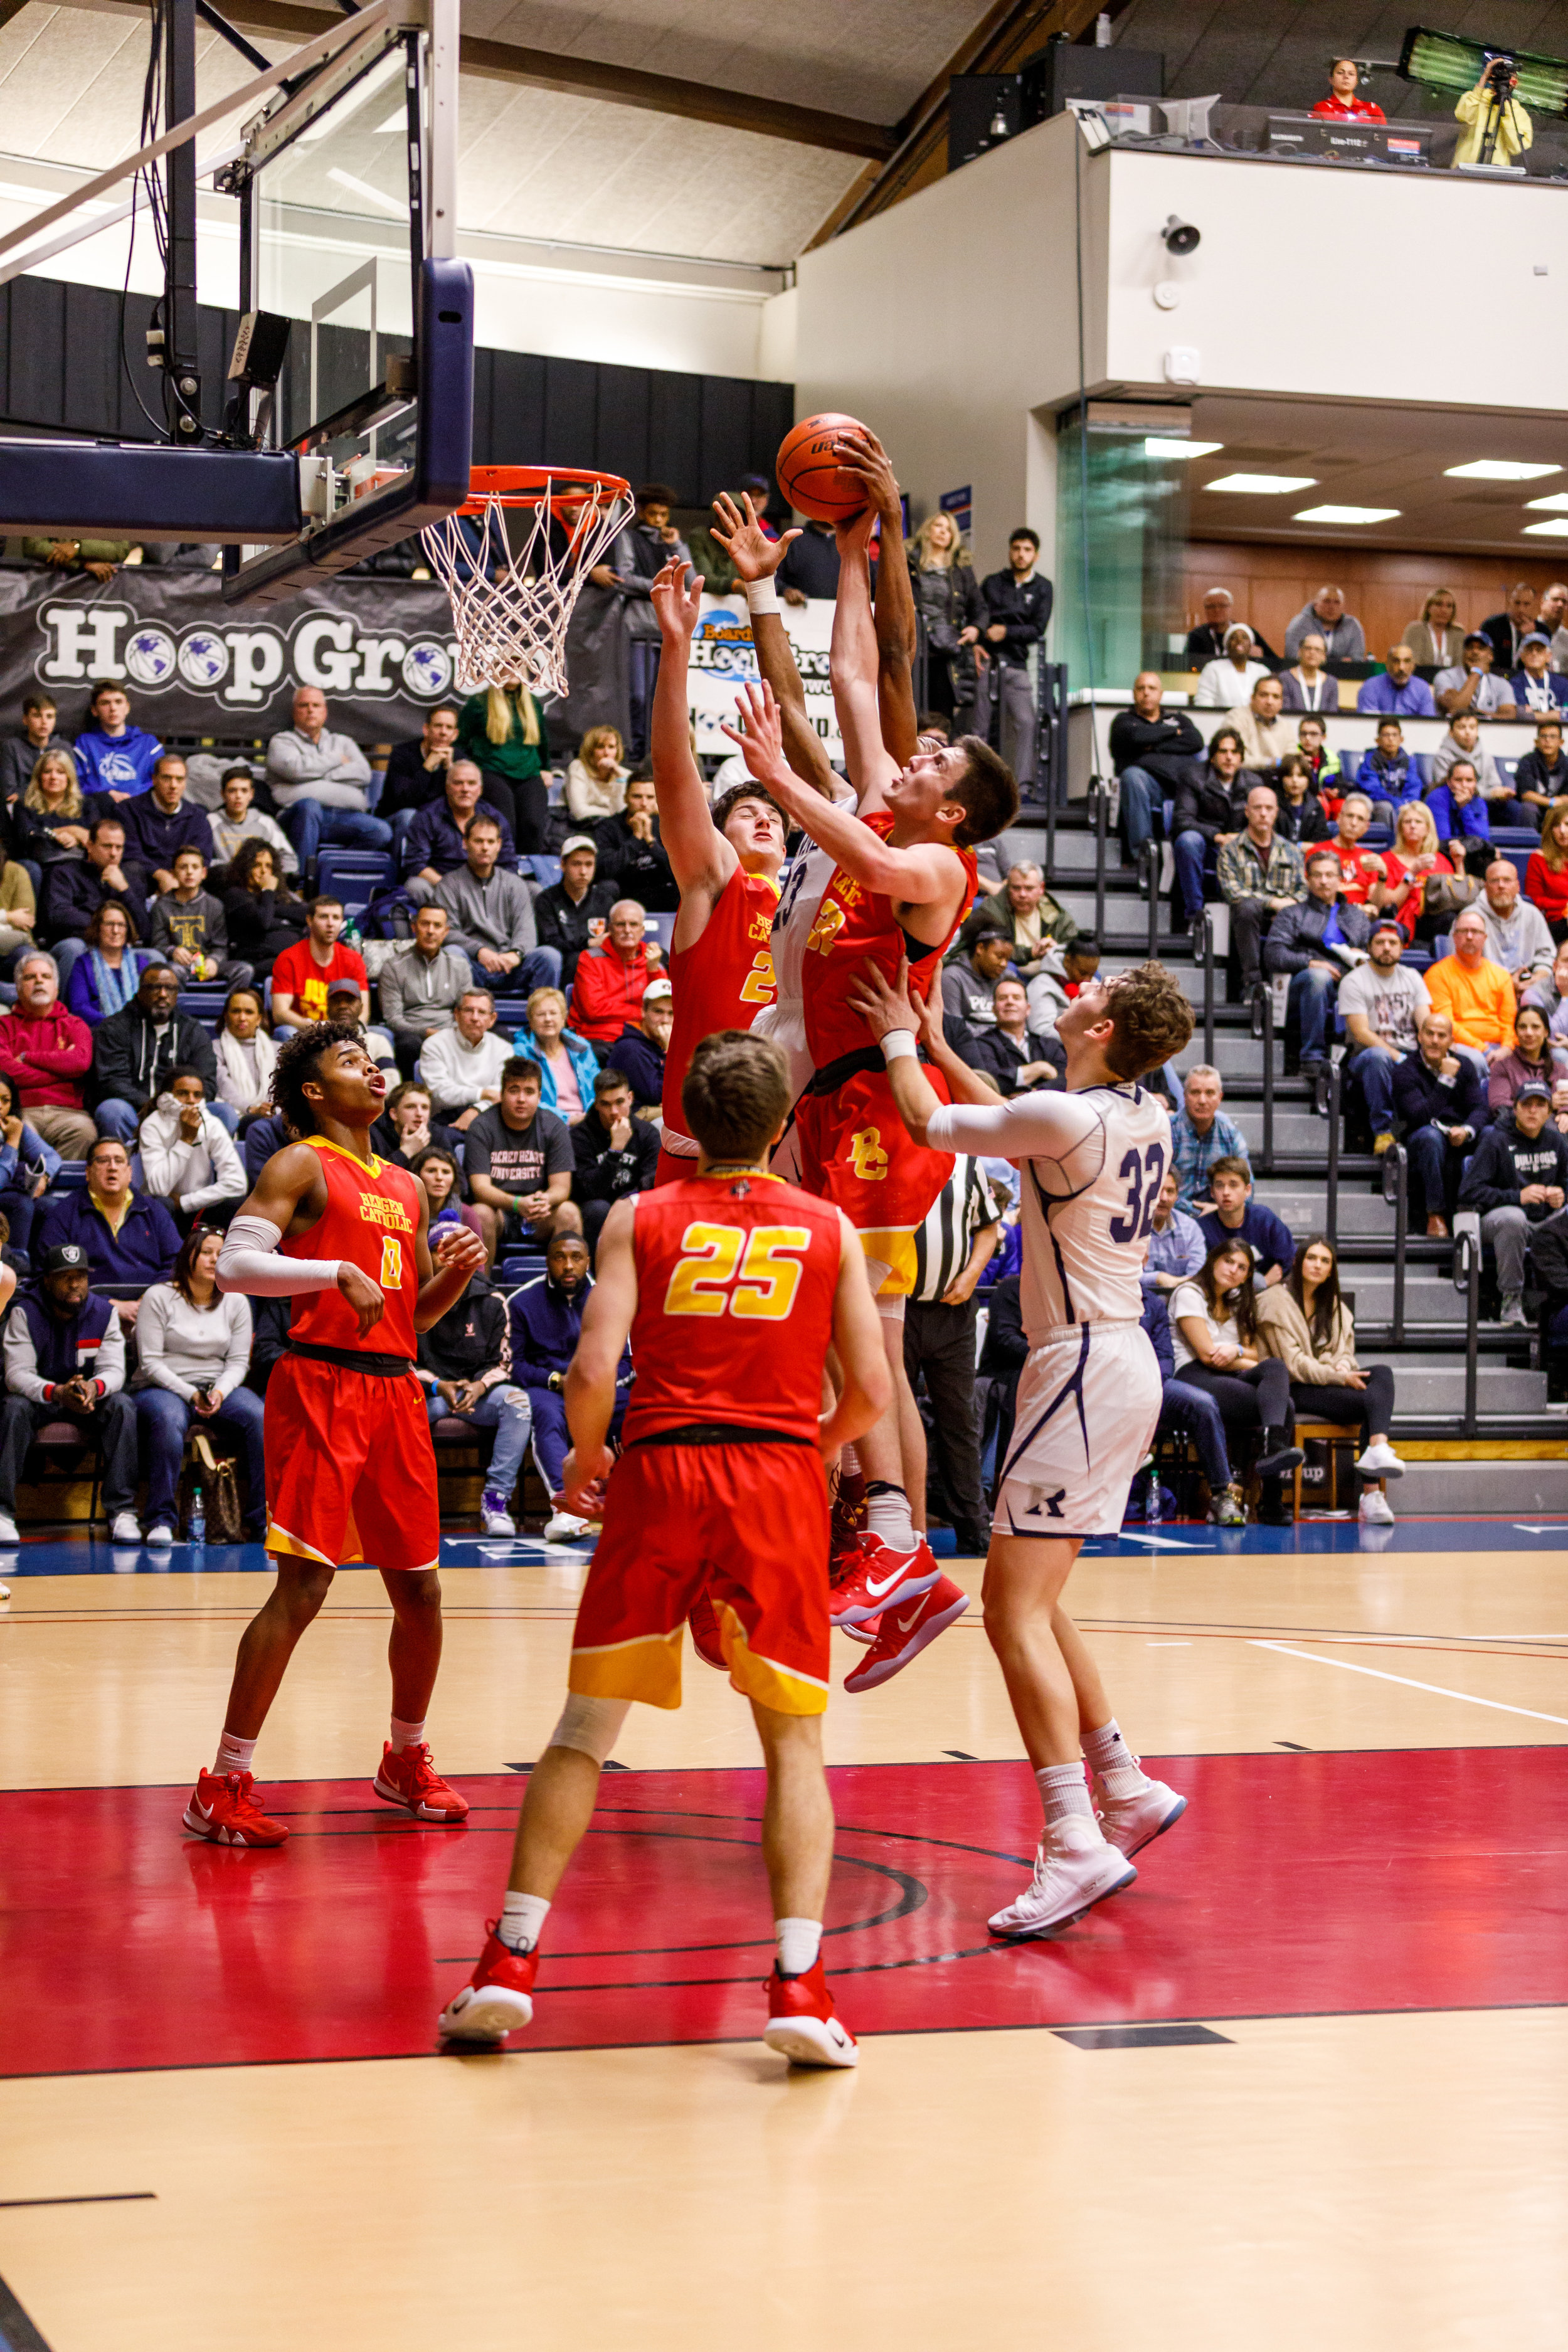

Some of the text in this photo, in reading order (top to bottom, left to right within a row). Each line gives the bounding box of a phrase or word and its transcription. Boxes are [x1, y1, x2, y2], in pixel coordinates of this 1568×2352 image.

[490, 1150, 544, 1165] SACRED HEART
[1514, 1150, 1557, 1169] BULLDOGS
[490, 1166, 541, 1180] UNIVERSITY
[359, 1192, 406, 1217] BERGEN
[1109, 1142, 1165, 1244] 32
[380, 1236, 402, 1290] 0
[664, 1221, 812, 1321] 25
